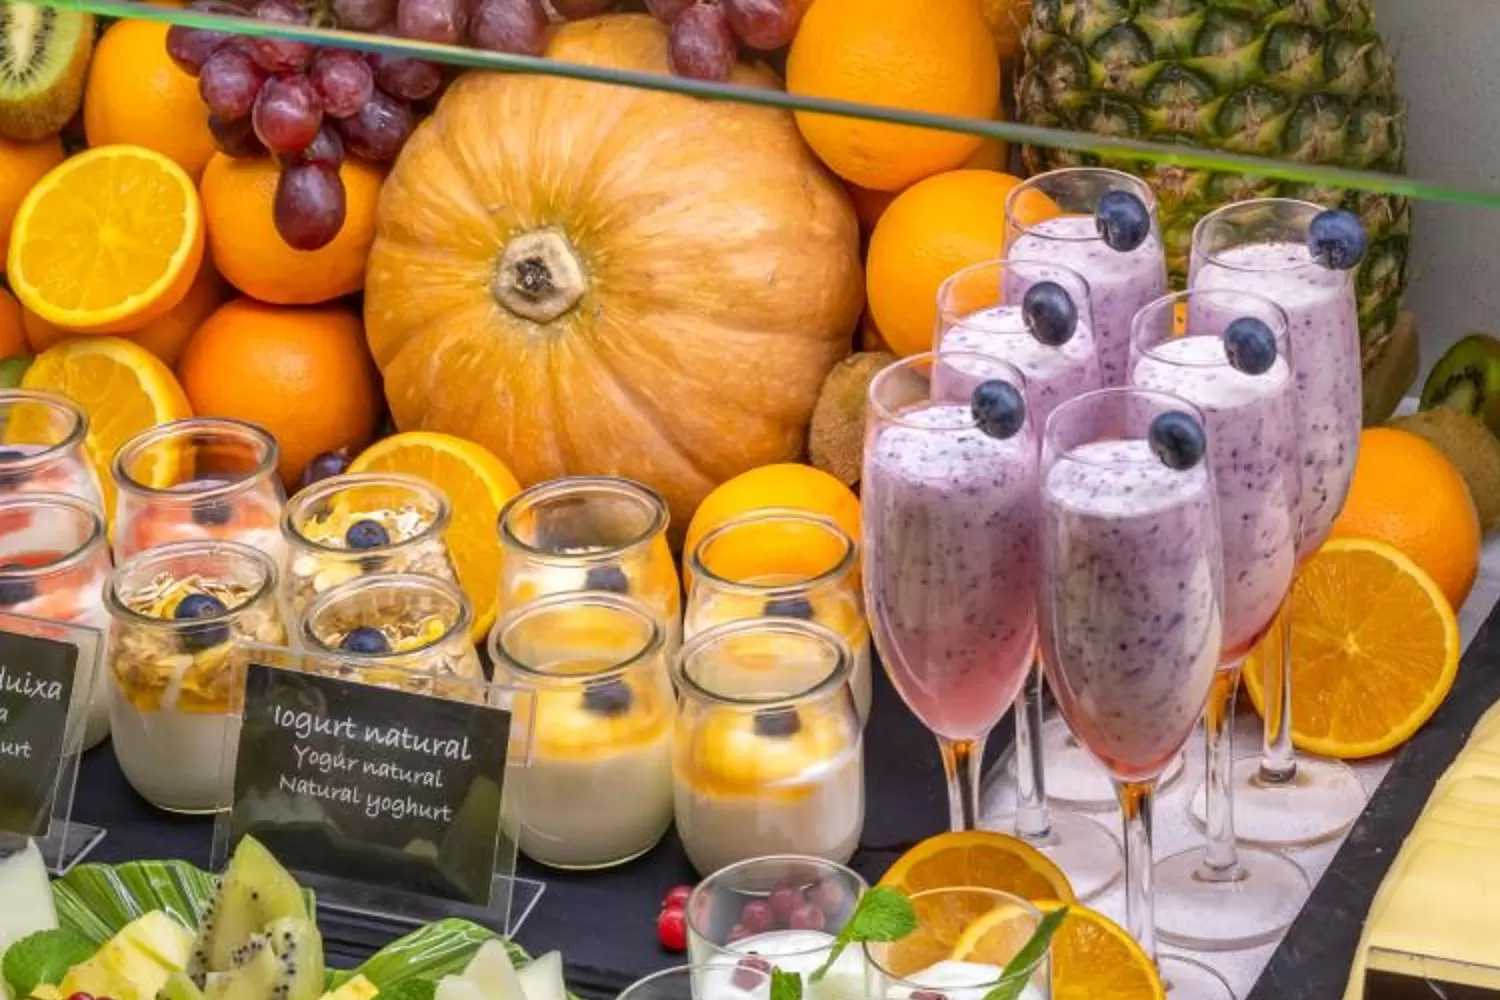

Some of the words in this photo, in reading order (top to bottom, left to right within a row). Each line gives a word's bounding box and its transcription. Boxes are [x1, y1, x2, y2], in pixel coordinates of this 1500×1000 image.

[274, 704, 357, 739] Iogurt
[364, 725, 472, 761] natural
[279, 773, 361, 805] Natural
[365, 793, 453, 822] yoghurt
[362, 760, 443, 788] natural
